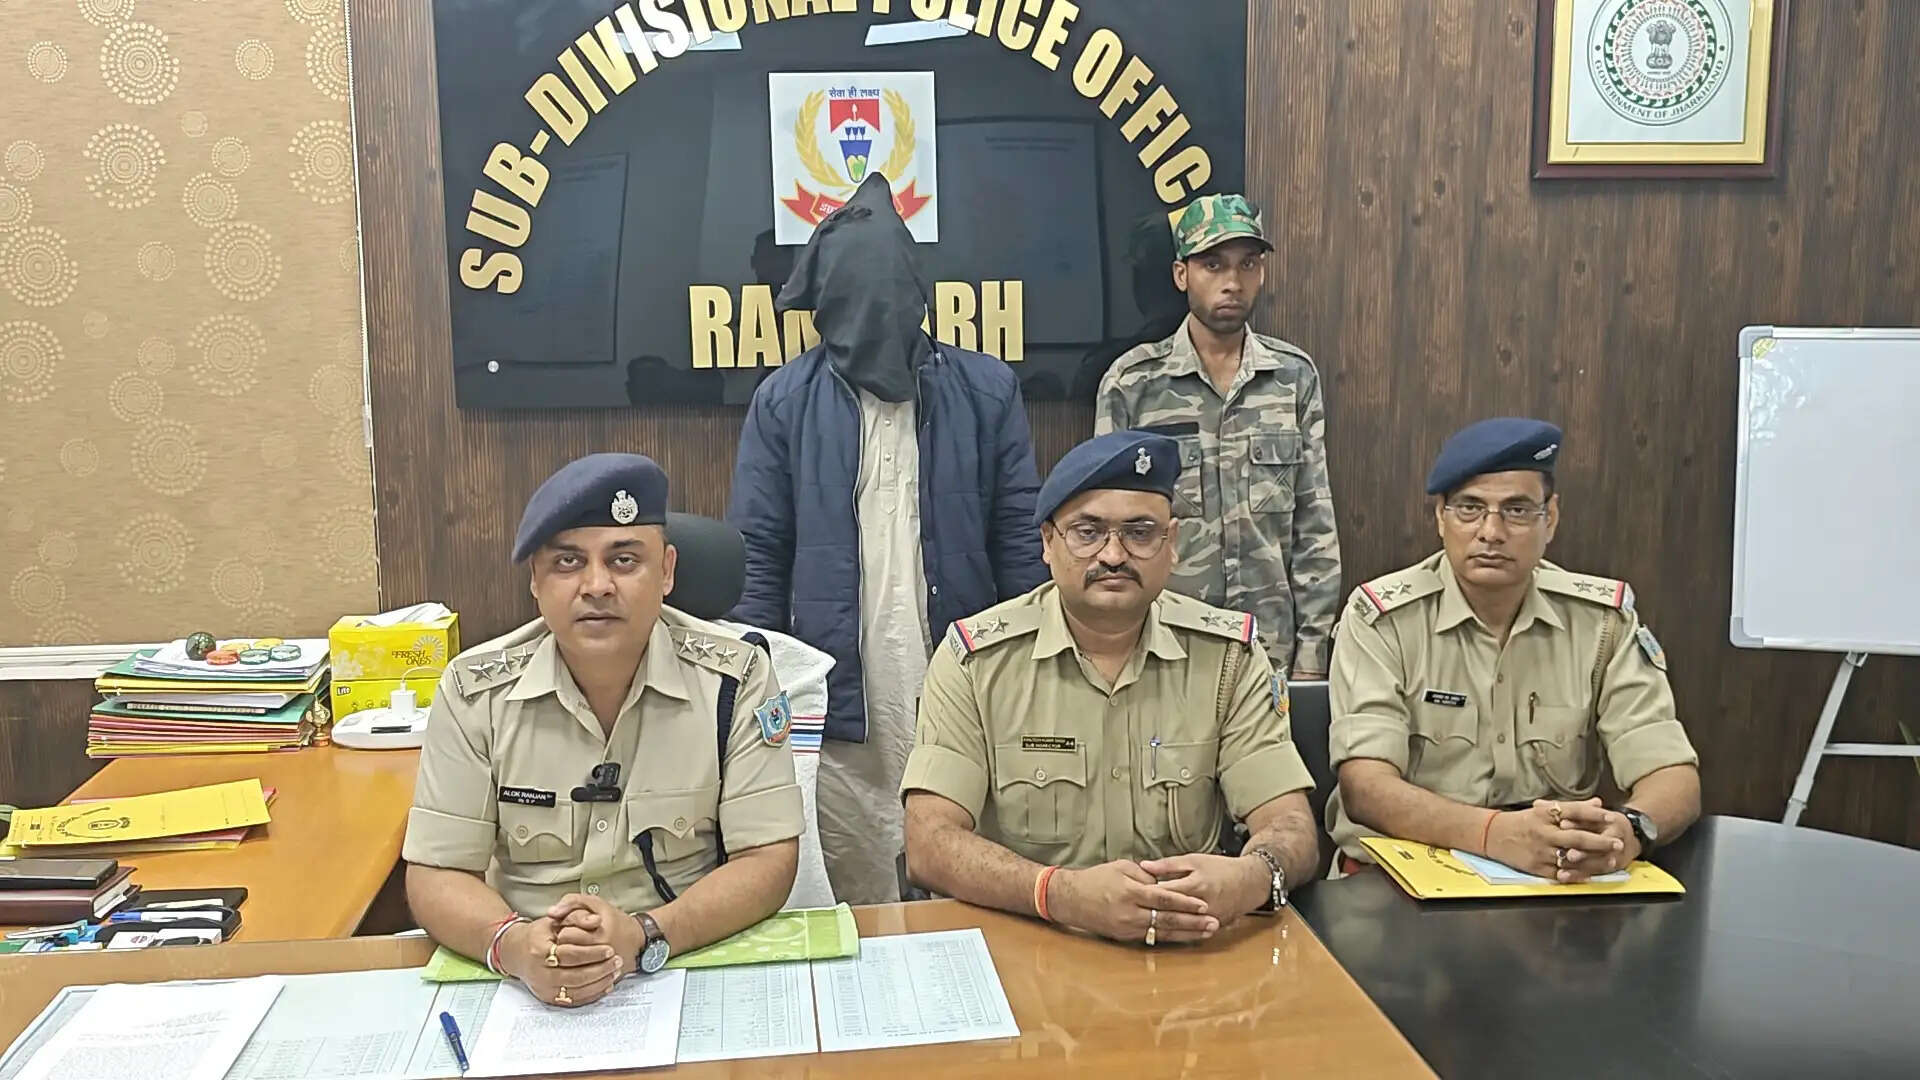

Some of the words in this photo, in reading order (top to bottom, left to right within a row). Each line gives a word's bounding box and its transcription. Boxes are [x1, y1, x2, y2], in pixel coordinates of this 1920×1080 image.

[1595, 60, 1651, 118] GOVERNMENT
[1653, 110, 1668, 119] OF
[1670, 60, 1724, 117] JHARKHAND
[459, 0, 857, 294] SUB-DIVISI
[872, 0, 1080, 71] LICE
[1072, 28, 1212, 234] OFFIC
[689, 280, 1024, 368] RARH
[392, 650, 425, 659] FRESH
[521, 791, 546, 800] RANJAN
